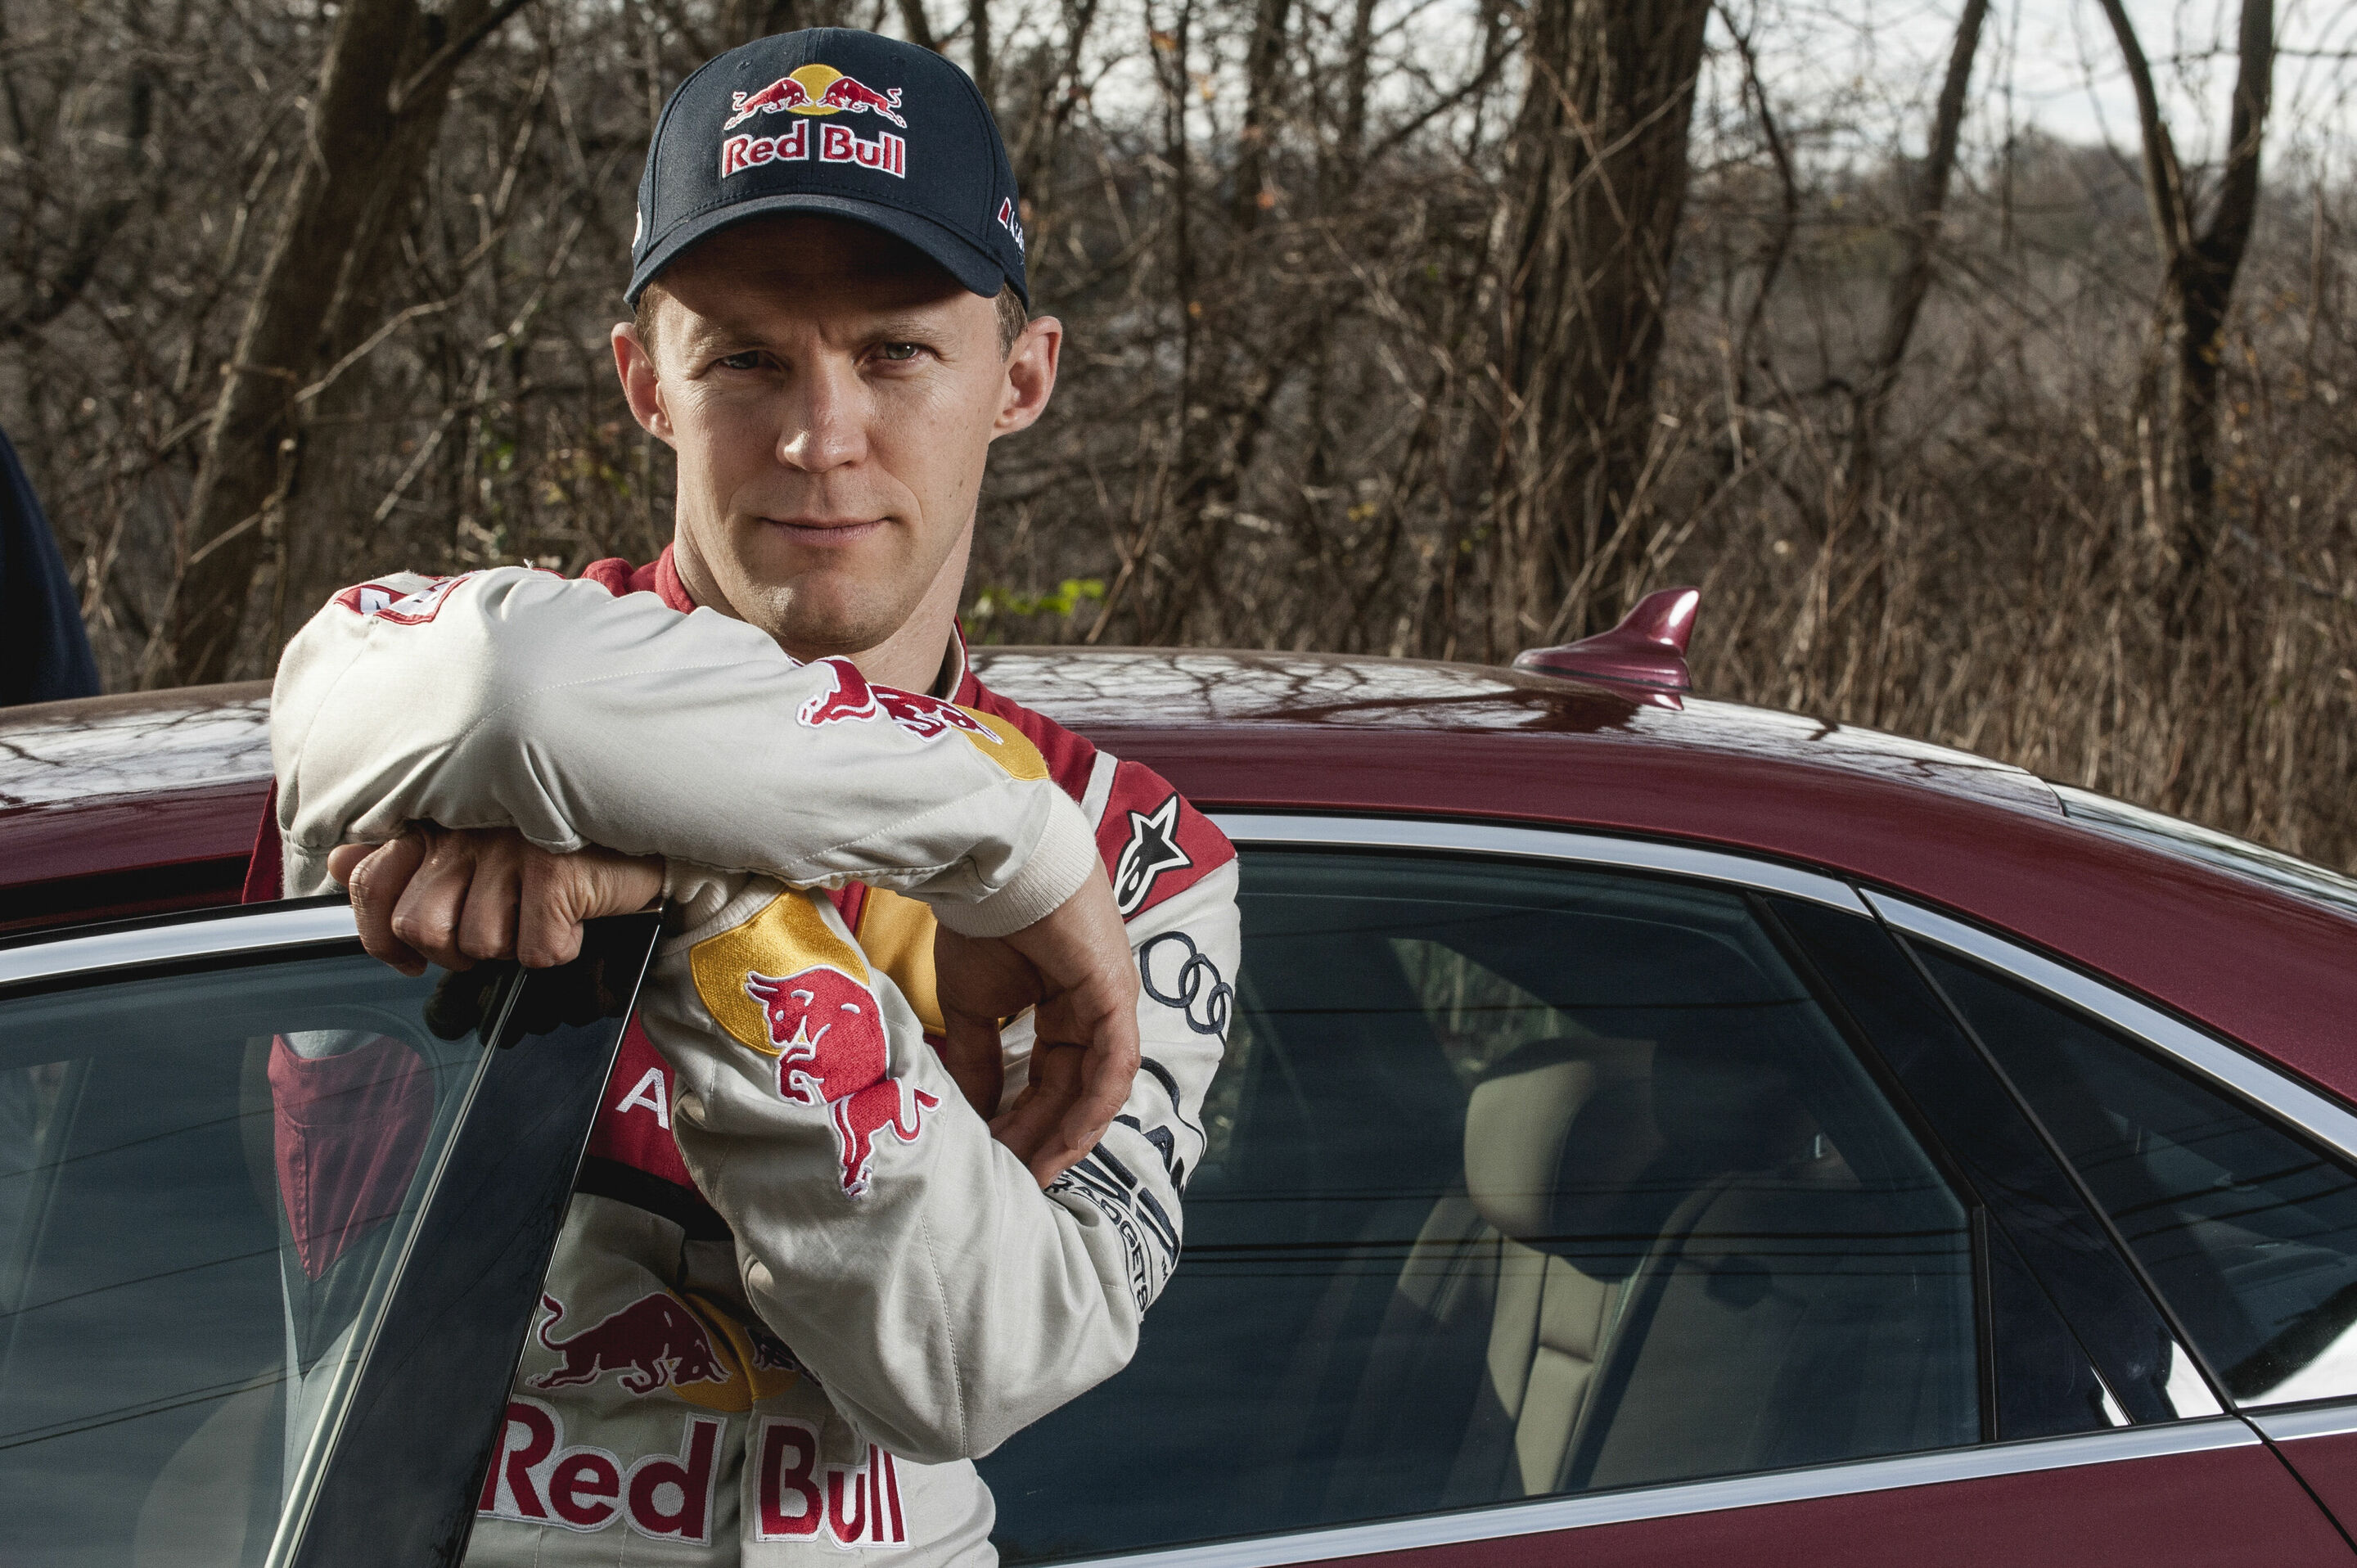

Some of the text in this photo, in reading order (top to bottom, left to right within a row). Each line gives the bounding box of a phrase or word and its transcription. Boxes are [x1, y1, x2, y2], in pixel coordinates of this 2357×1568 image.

[723, 119, 905, 178] Red Bull
[1051, 1175, 1148, 1312] ADGETS
[480, 1401, 910, 1548] Red Bull
